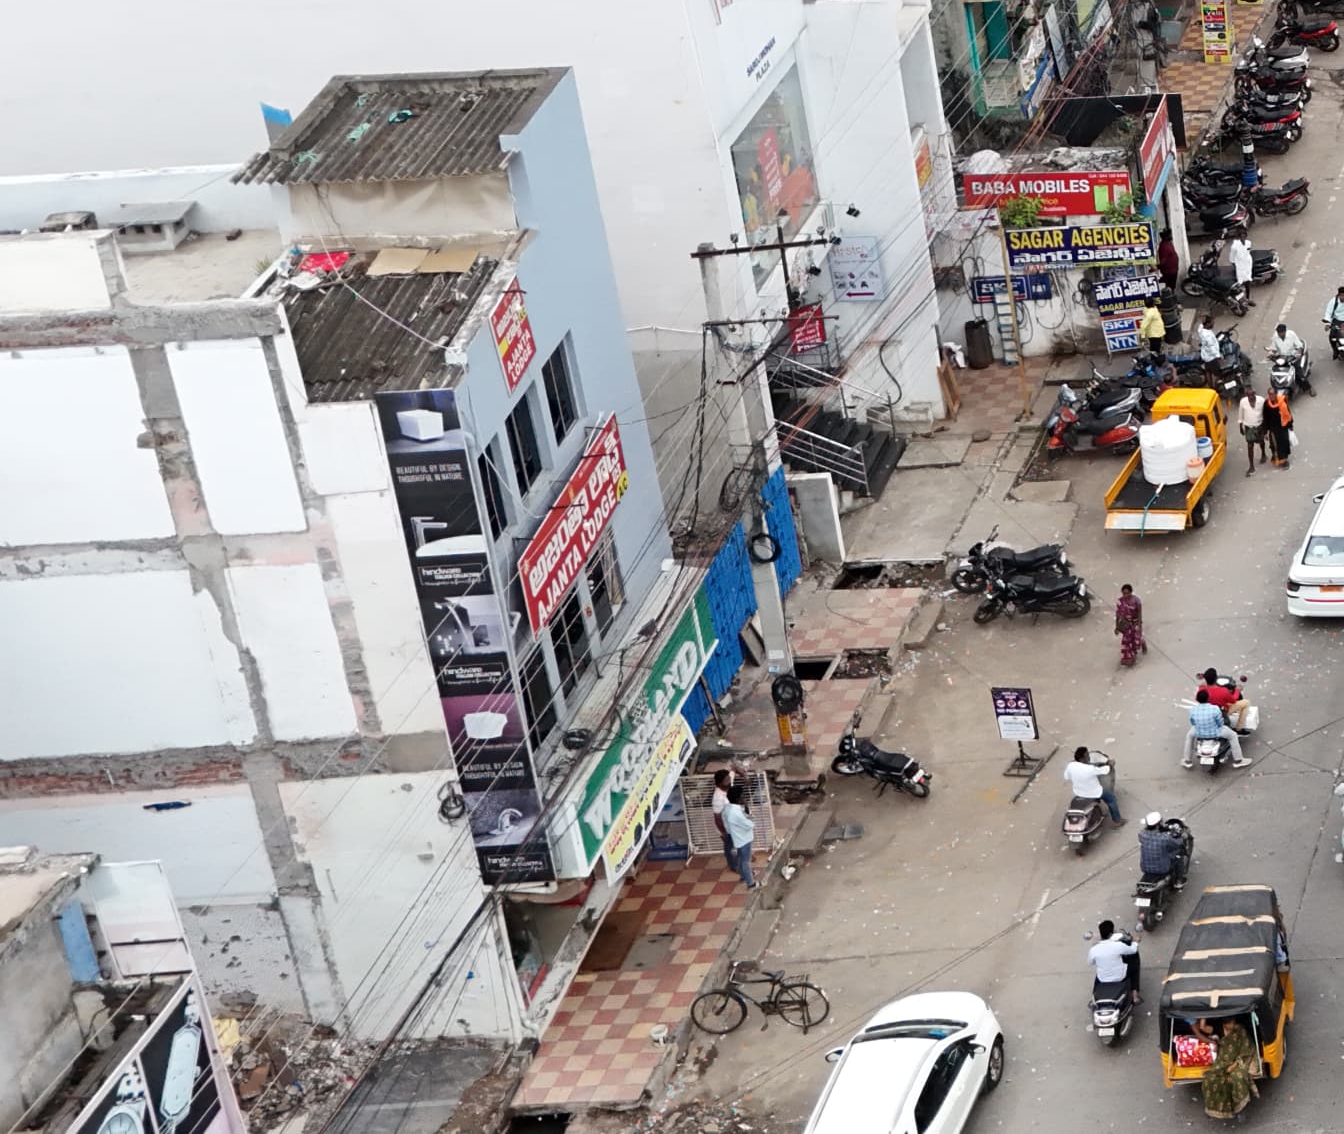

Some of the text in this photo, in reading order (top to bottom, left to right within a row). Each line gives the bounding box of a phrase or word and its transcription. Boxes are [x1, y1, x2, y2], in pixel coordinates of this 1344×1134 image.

[971, 179, 1090, 195] BABA MOBILES
[1009, 225, 1151, 250] SAGAR AGENCIES
[981, 282, 1021, 294] SKF
[1099, 301, 1124, 313] SAGAR
[1104, 320, 1133, 331] SKF
[1109, 336, 1138, 350] NTN
[506, 328, 532, 376] AJANTA
[511, 344, 533, 384] LODGE
[396, 466, 428, 474] BEAUTIFUL
[537, 485, 617, 626] AJANTA LODGE
[422, 567, 462, 576] hindware
[444, 666, 482, 675] hindware
[583, 640, 698, 840] WOODLAND
